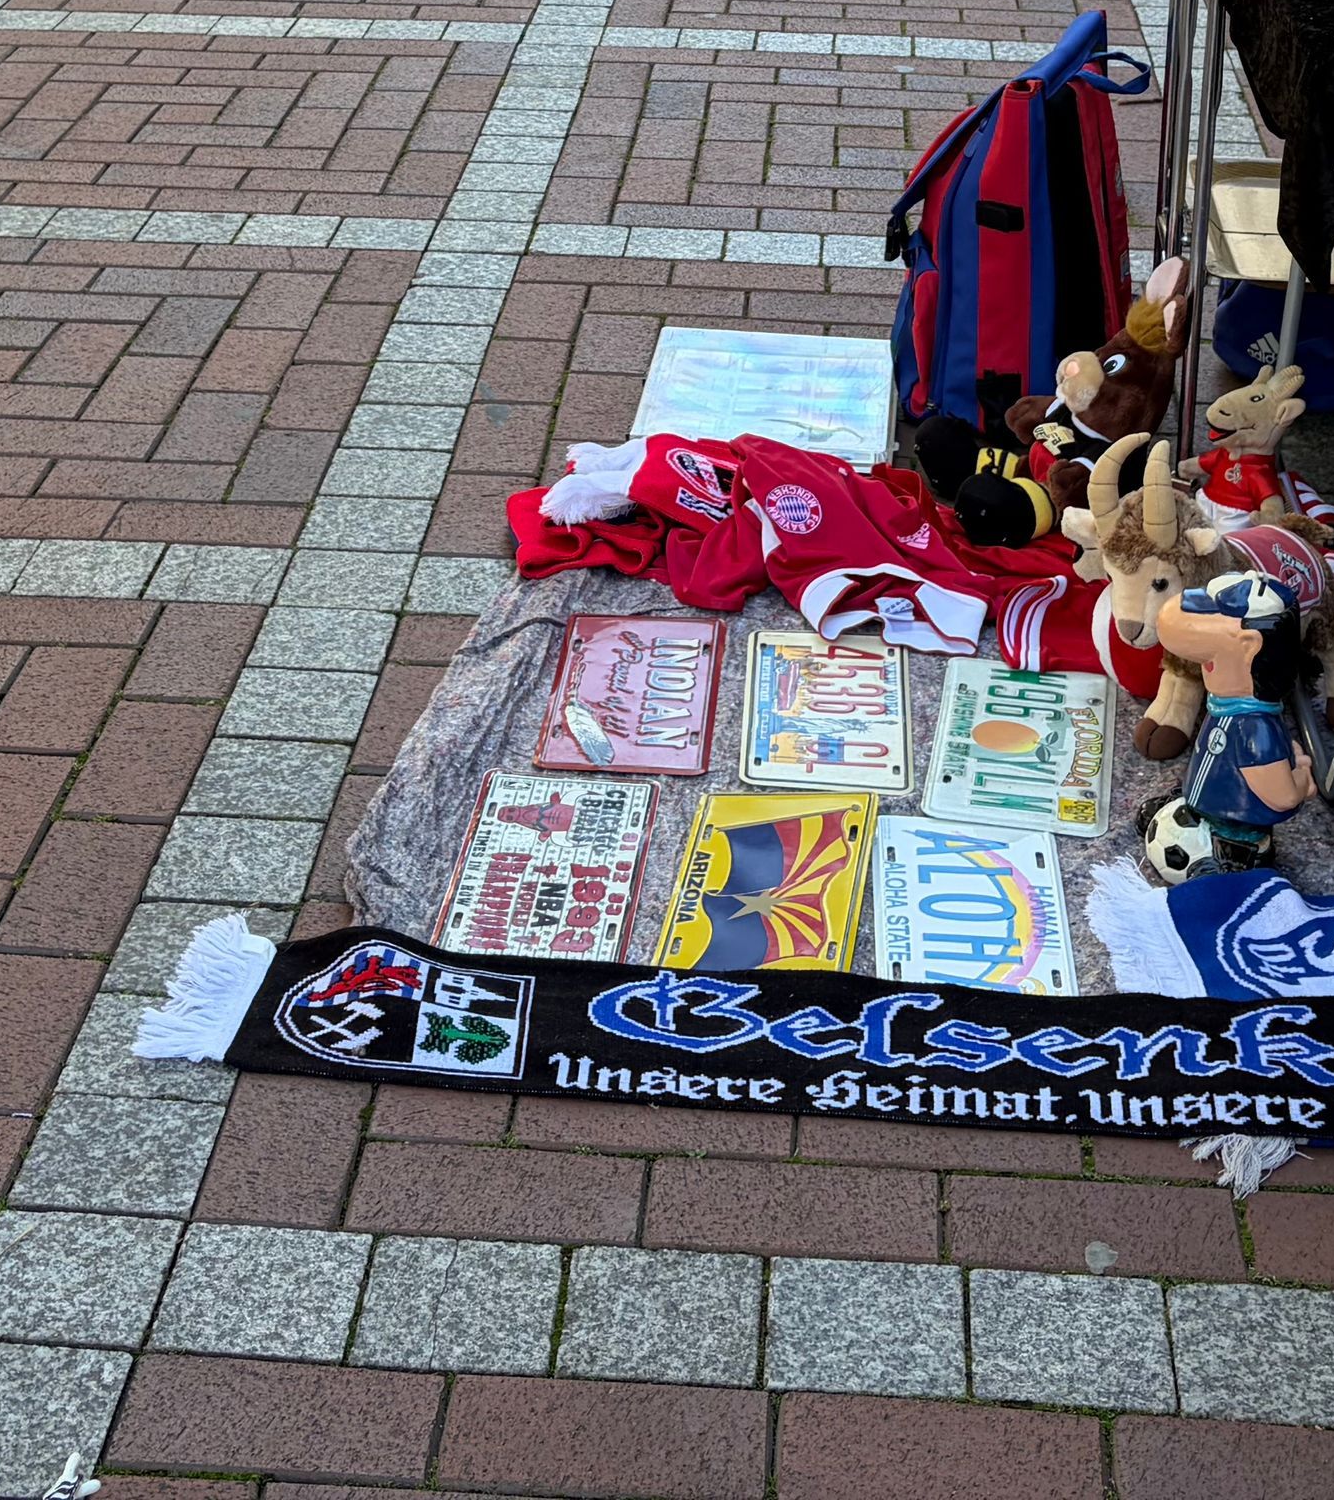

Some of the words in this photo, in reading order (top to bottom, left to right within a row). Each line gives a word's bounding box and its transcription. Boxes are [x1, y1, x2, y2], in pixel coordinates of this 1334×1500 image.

[767, 506, 808, 532] BAYERN
[806, 512, 820, 530] FC
[635, 637, 701, 750] INDIAN
[806, 646, 889, 716] 4536
[883, 660, 897, 687] NEW
[884, 689, 899, 717] YORK
[950, 689, 979, 739] SUNSHINE
[943, 742, 970, 777] STATE
[1061, 707, 1104, 788] FLORIDA
[471, 829, 492, 858] TIMES
[572, 798, 602, 843] BULLS
[593, 790, 626, 856] CHICAGO
[467, 860, 482, 872] IN
[676, 850, 708, 925] ARIZONA
[884, 862, 908, 909] ALOHA
[456, 885, 475, 907] ROW
[465, 852, 533, 951] CHAMPIONS
[513, 881, 538, 928] WORLD
[531, 882, 566, 928] NBA
[550, 863, 611, 953] 1993
[1027, 886, 1062, 950] HAWAII
[887, 914, 911, 962] STATE
[548, 1052, 783, 1105] Unsere
[1079, 1088, 1327, 1128] Unsere
